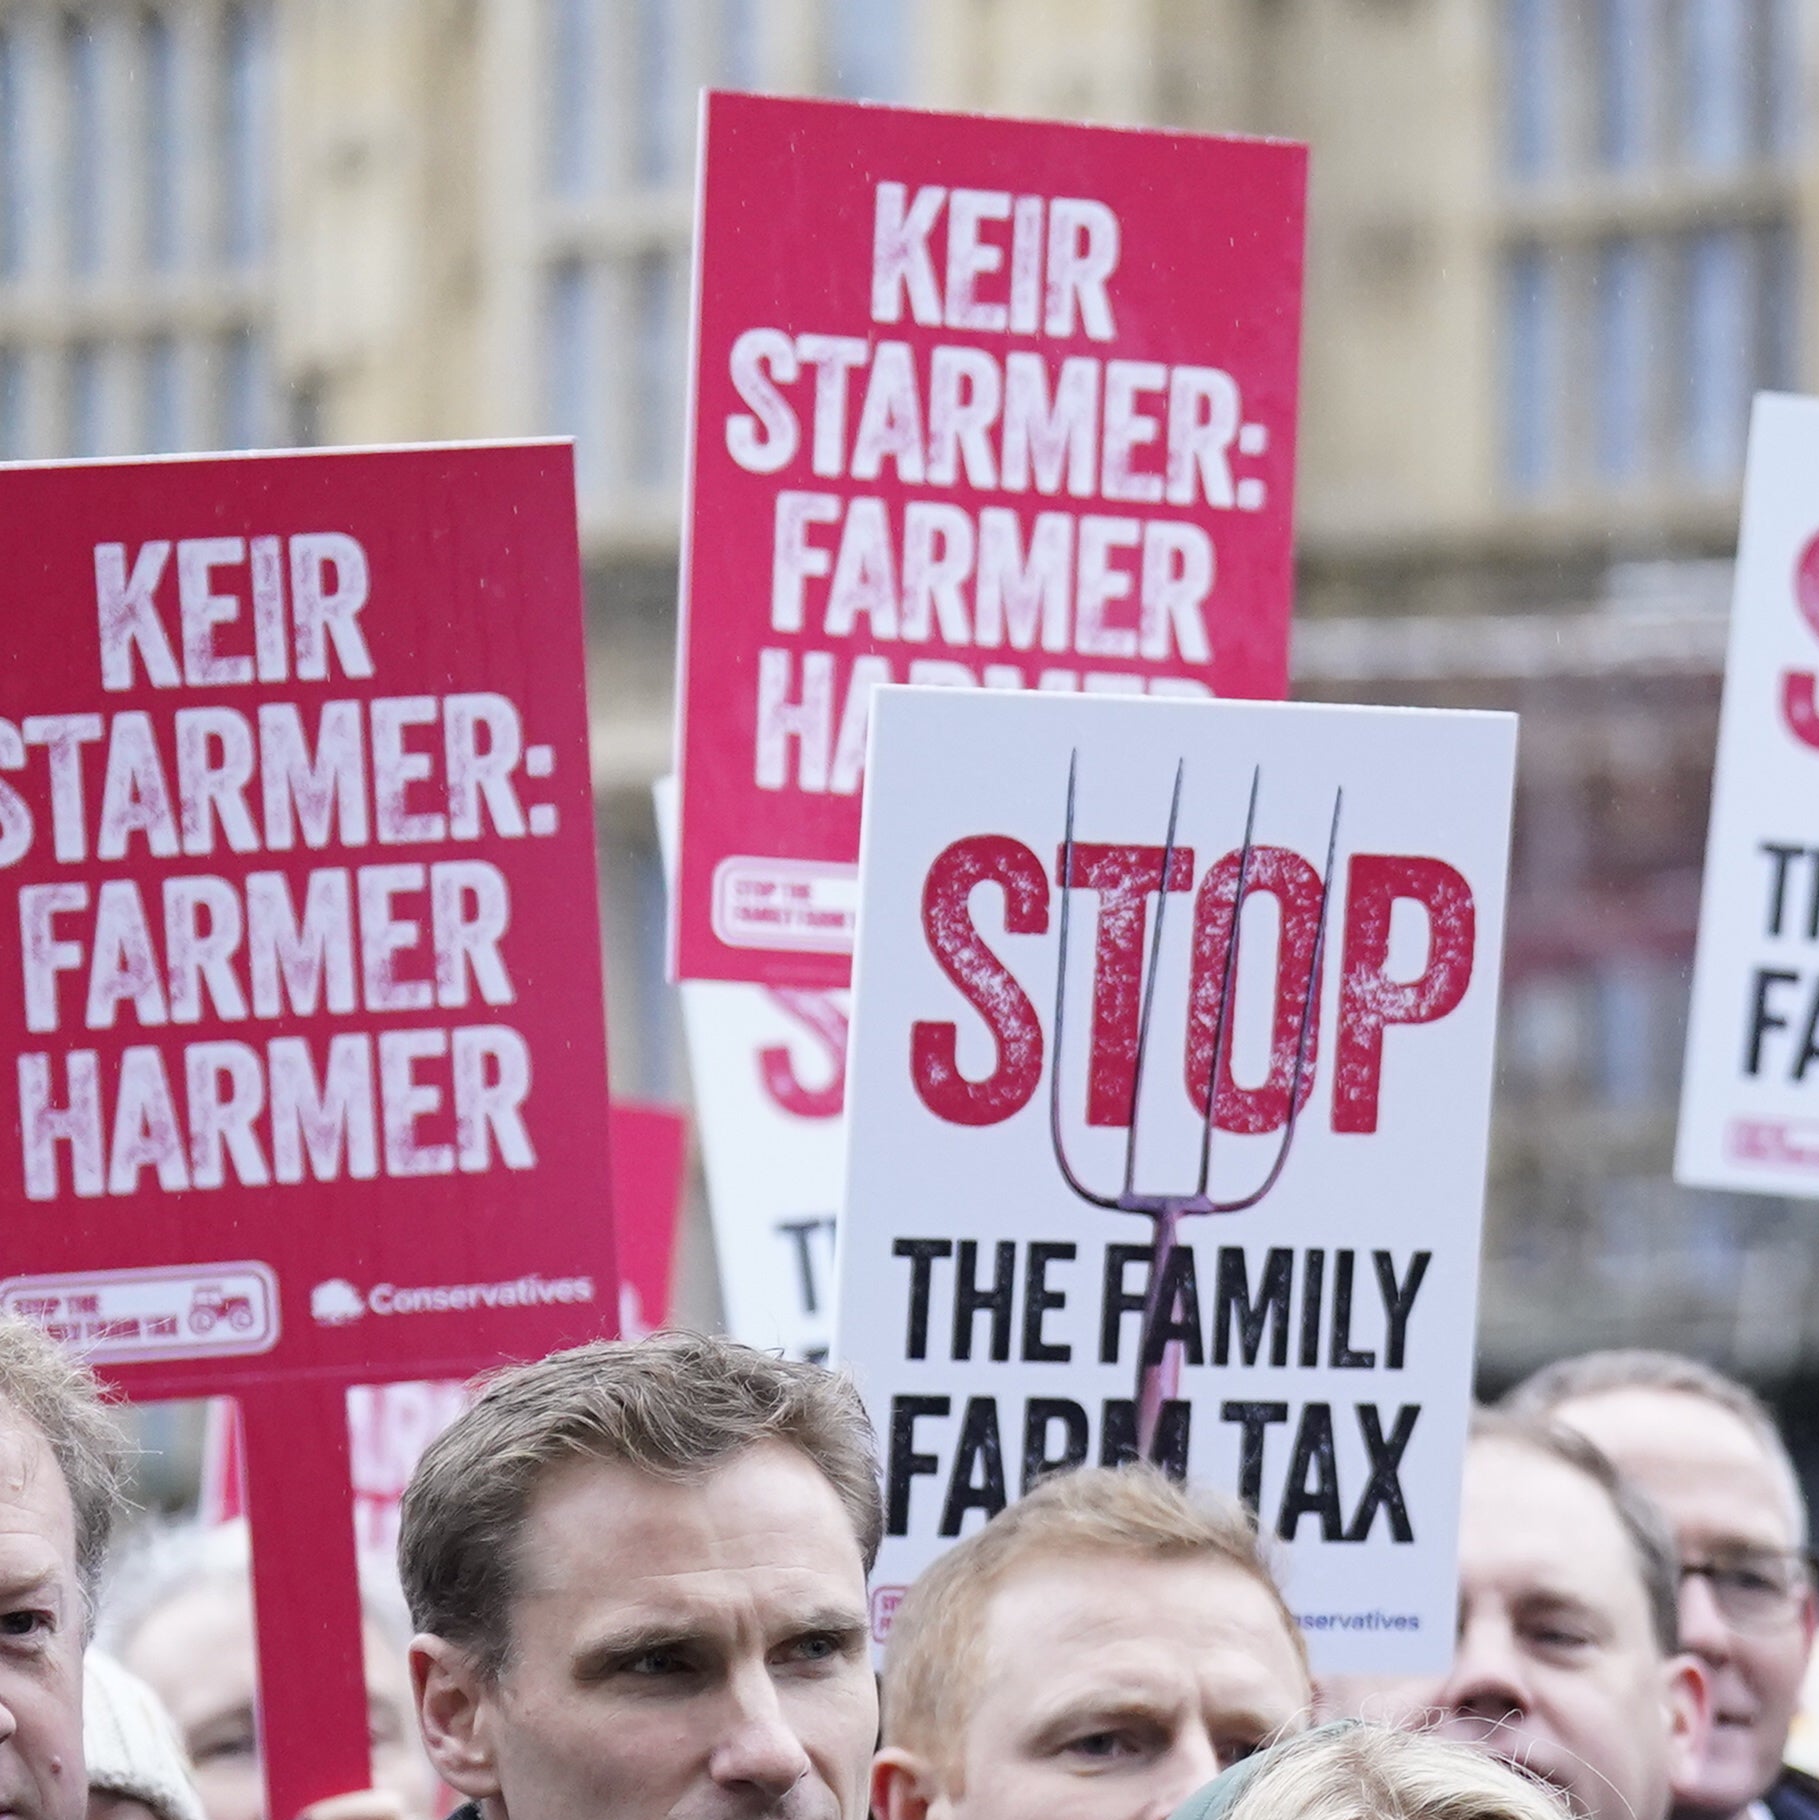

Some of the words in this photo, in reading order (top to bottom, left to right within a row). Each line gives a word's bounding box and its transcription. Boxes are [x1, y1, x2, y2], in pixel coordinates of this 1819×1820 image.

[870, 181, 1120, 341] KEIR
[725, 327, 1269, 511] STARMER:
[94, 532, 373, 692] KEIR
[771, 490, 1216, 664] FARMER
[18, 857, 517, 1034] FARMER
[909, 834, 1476, 1135] STOP
[16, 1024, 538, 1201] HARMER
[368, 1273, 595, 1316] Conservatives
[892, 1239, 1077, 1362] THE
[1099, 1242, 1432, 1370] FAMILY
[1220, 1400, 1422, 1544] TAX
